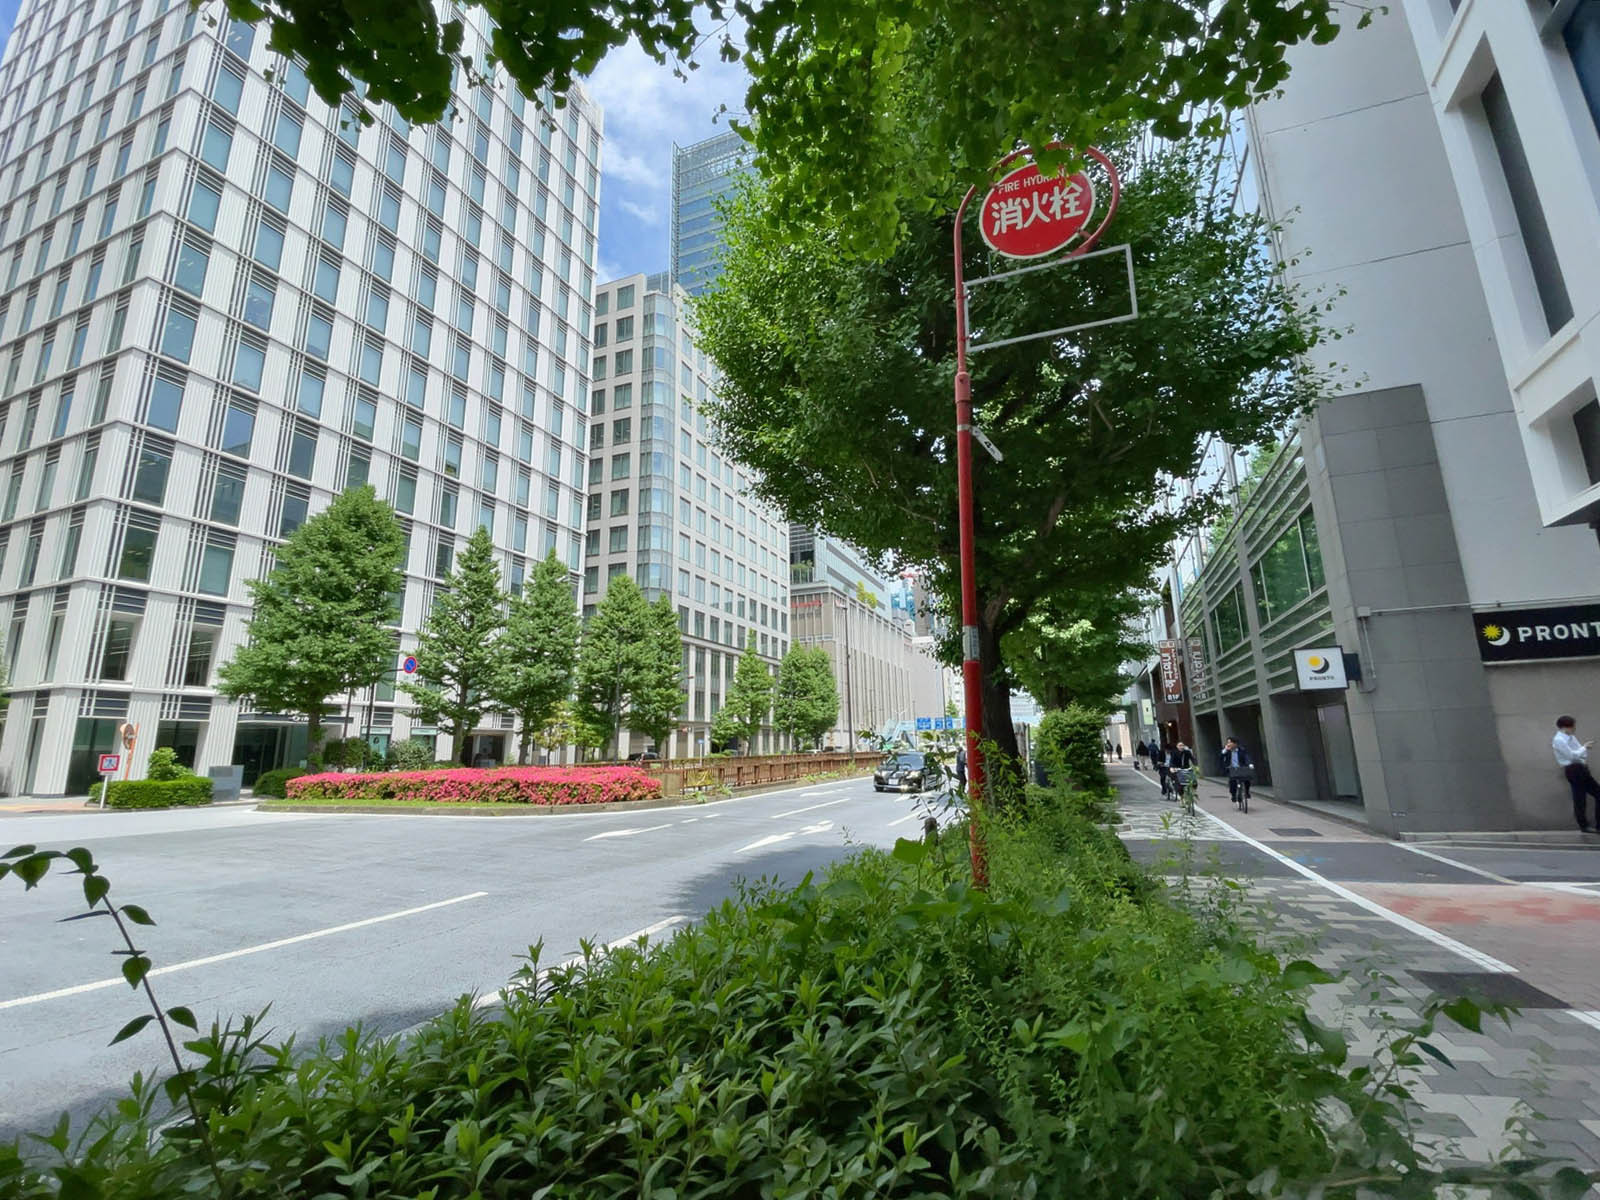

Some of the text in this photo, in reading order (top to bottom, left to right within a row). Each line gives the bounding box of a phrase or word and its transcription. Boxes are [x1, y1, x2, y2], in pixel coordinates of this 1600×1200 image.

[999, 180, 1020, 194] FIRE
[991, 182, 1084, 236] 消火栓
